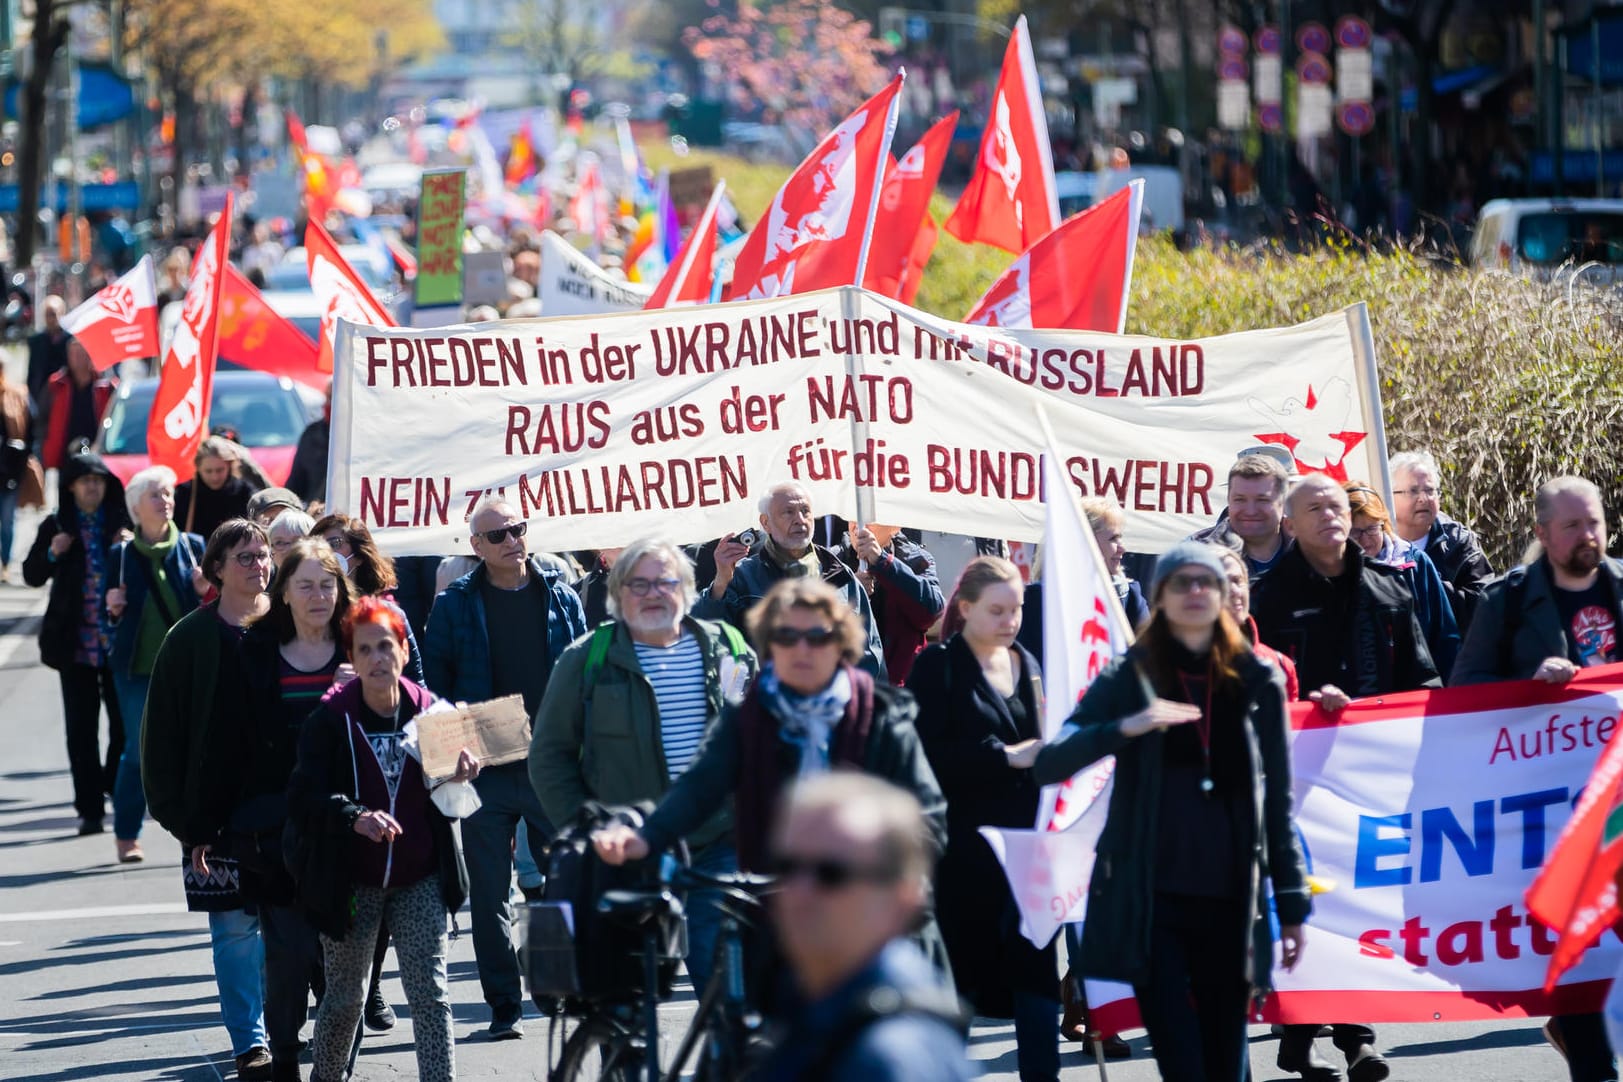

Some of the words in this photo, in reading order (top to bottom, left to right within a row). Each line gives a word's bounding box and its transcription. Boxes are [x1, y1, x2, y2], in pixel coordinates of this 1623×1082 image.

[367, 336, 526, 388] FRIEDEN
[537, 336, 573, 386] in
[580, 333, 642, 382] der
[650, 310, 821, 378] UKRAINE
[830, 308, 900, 355] und
[986, 343, 1204, 397] RUSSLAND
[505, 400, 612, 456] RAUS
[630, 402, 705, 446] aus
[720, 385, 787, 434] der
[807, 375, 914, 425] NATO
[360, 475, 452, 529] NEIN
[518, 454, 748, 520] MILLIARDEN
[787, 437, 847, 482] für
[853, 438, 912, 488] die
[1354, 786, 1585, 889] ENT
